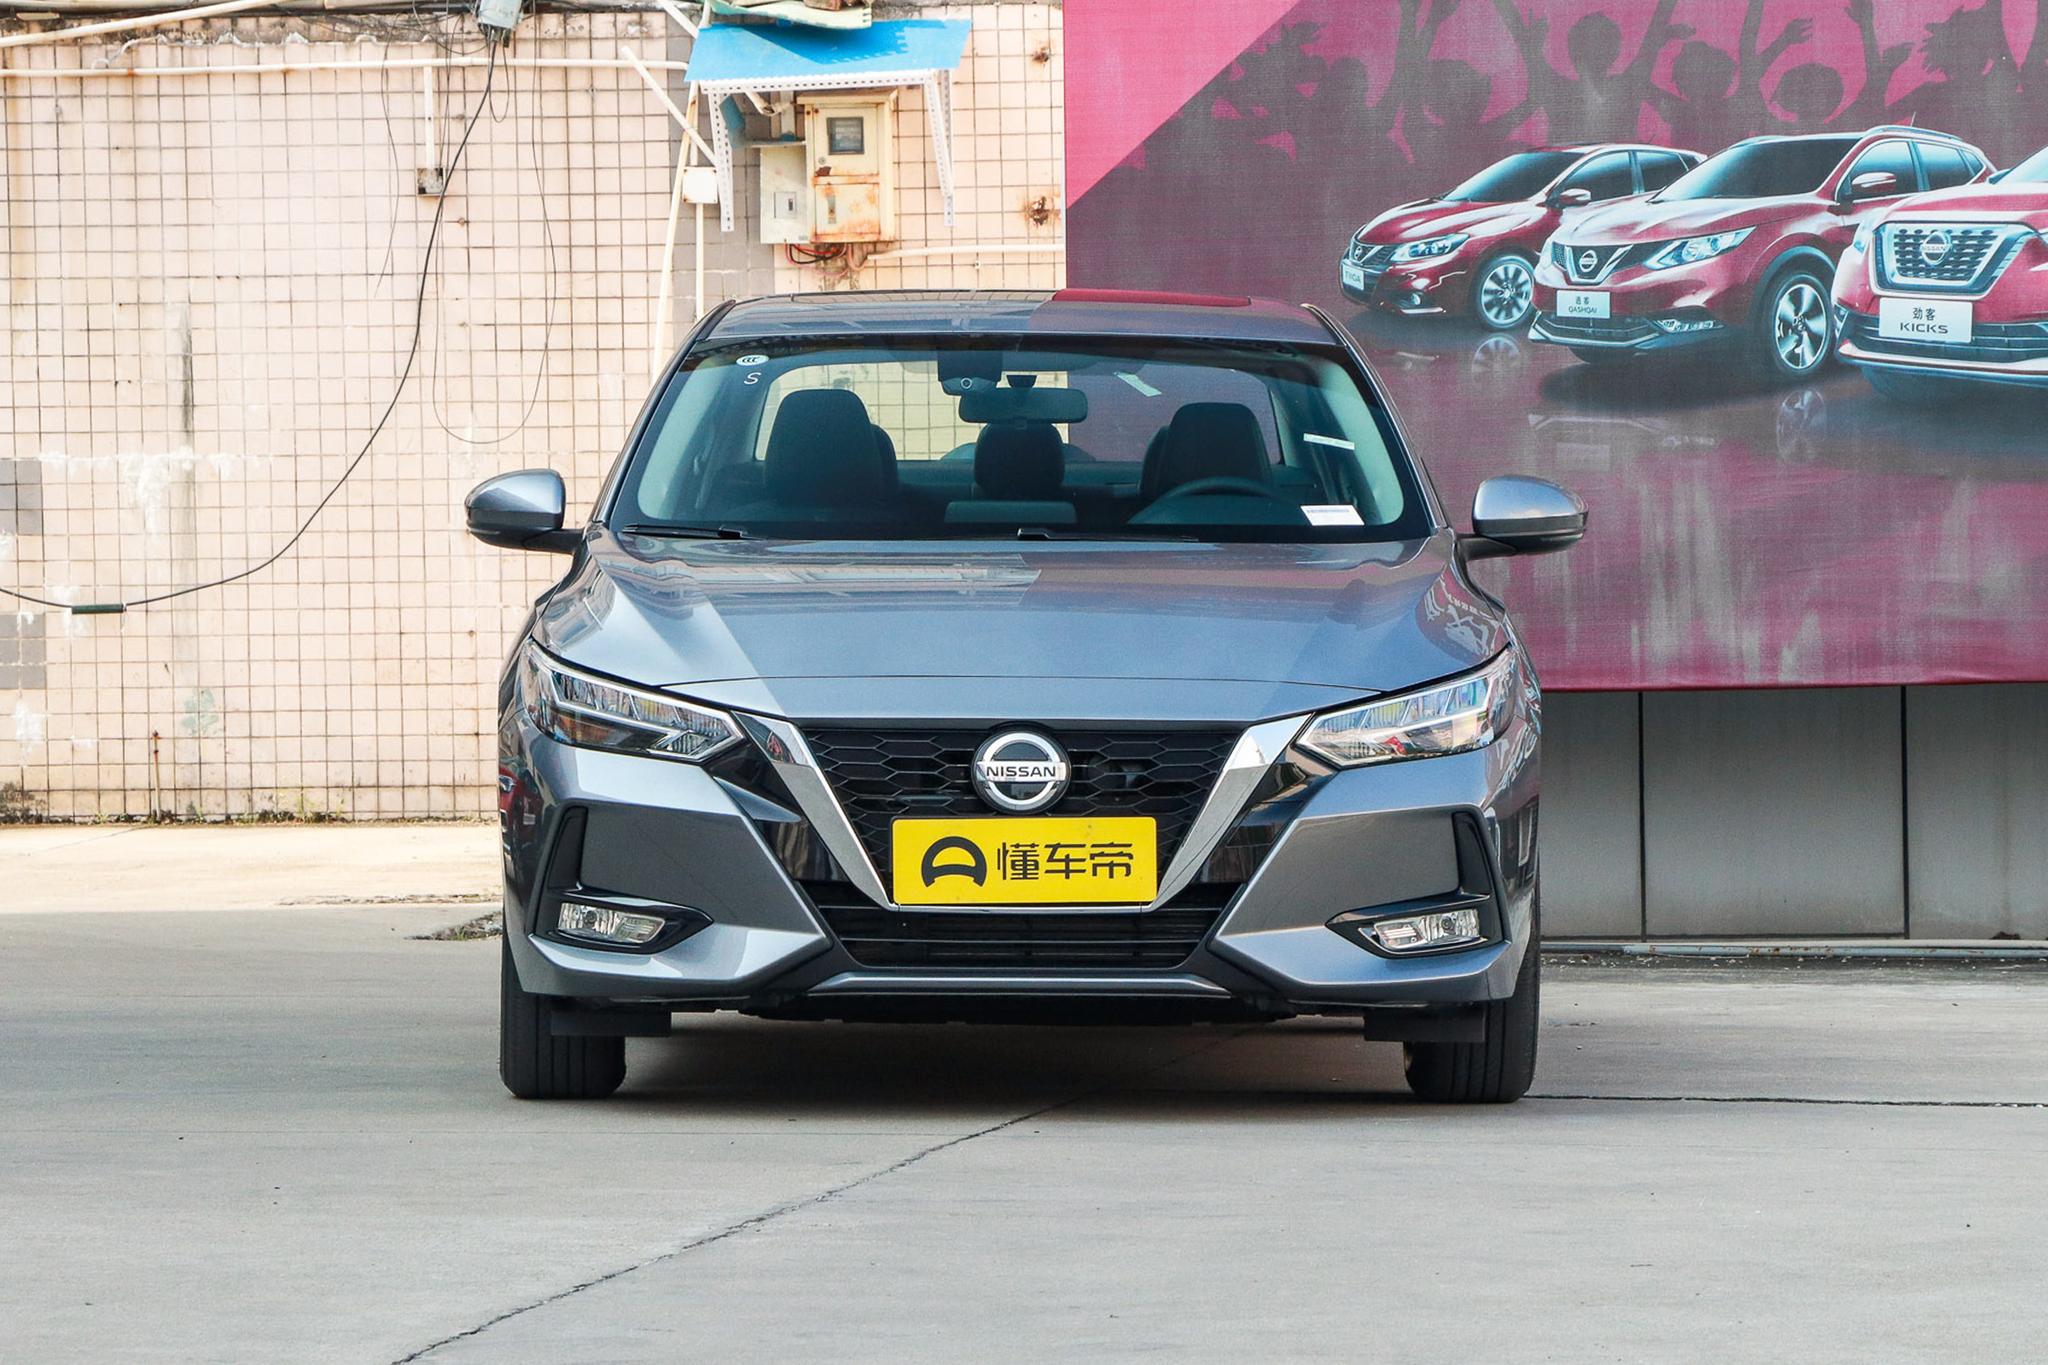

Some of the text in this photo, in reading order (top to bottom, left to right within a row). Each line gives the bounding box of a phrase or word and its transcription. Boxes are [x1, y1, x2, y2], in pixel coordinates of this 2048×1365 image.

[1912, 307, 1936, 321] 劲客
[1900, 322, 1949, 334] KICKS
[744, 372, 762, 385] S
[986, 765, 1057, 778] NISSAN
[997, 841, 1134, 881] 懂车帝
